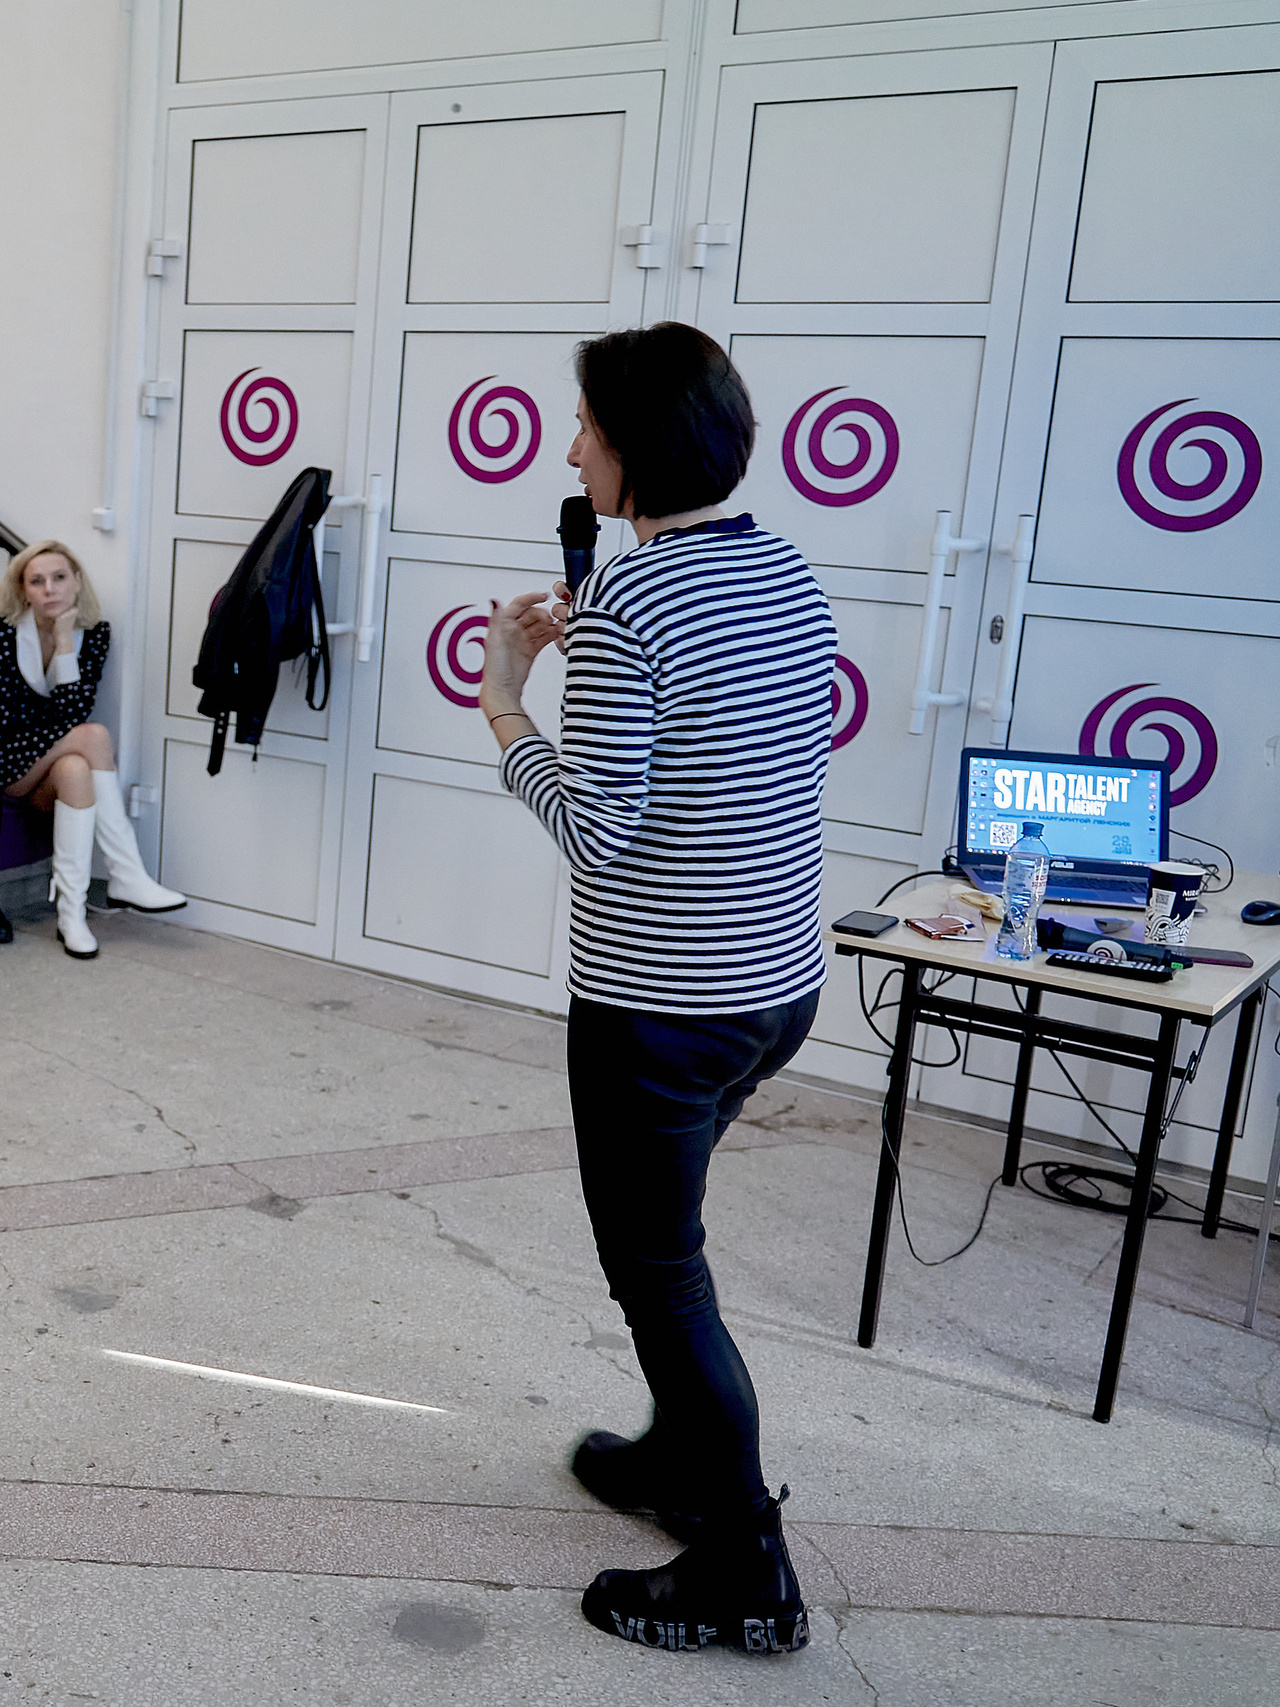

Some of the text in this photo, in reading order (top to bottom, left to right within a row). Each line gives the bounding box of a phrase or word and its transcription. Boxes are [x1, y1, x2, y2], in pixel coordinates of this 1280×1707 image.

[993, 768, 1066, 813] STAR
[1066, 773, 1131, 803] TALENT
[1066, 798, 1107, 816] AGENCY
